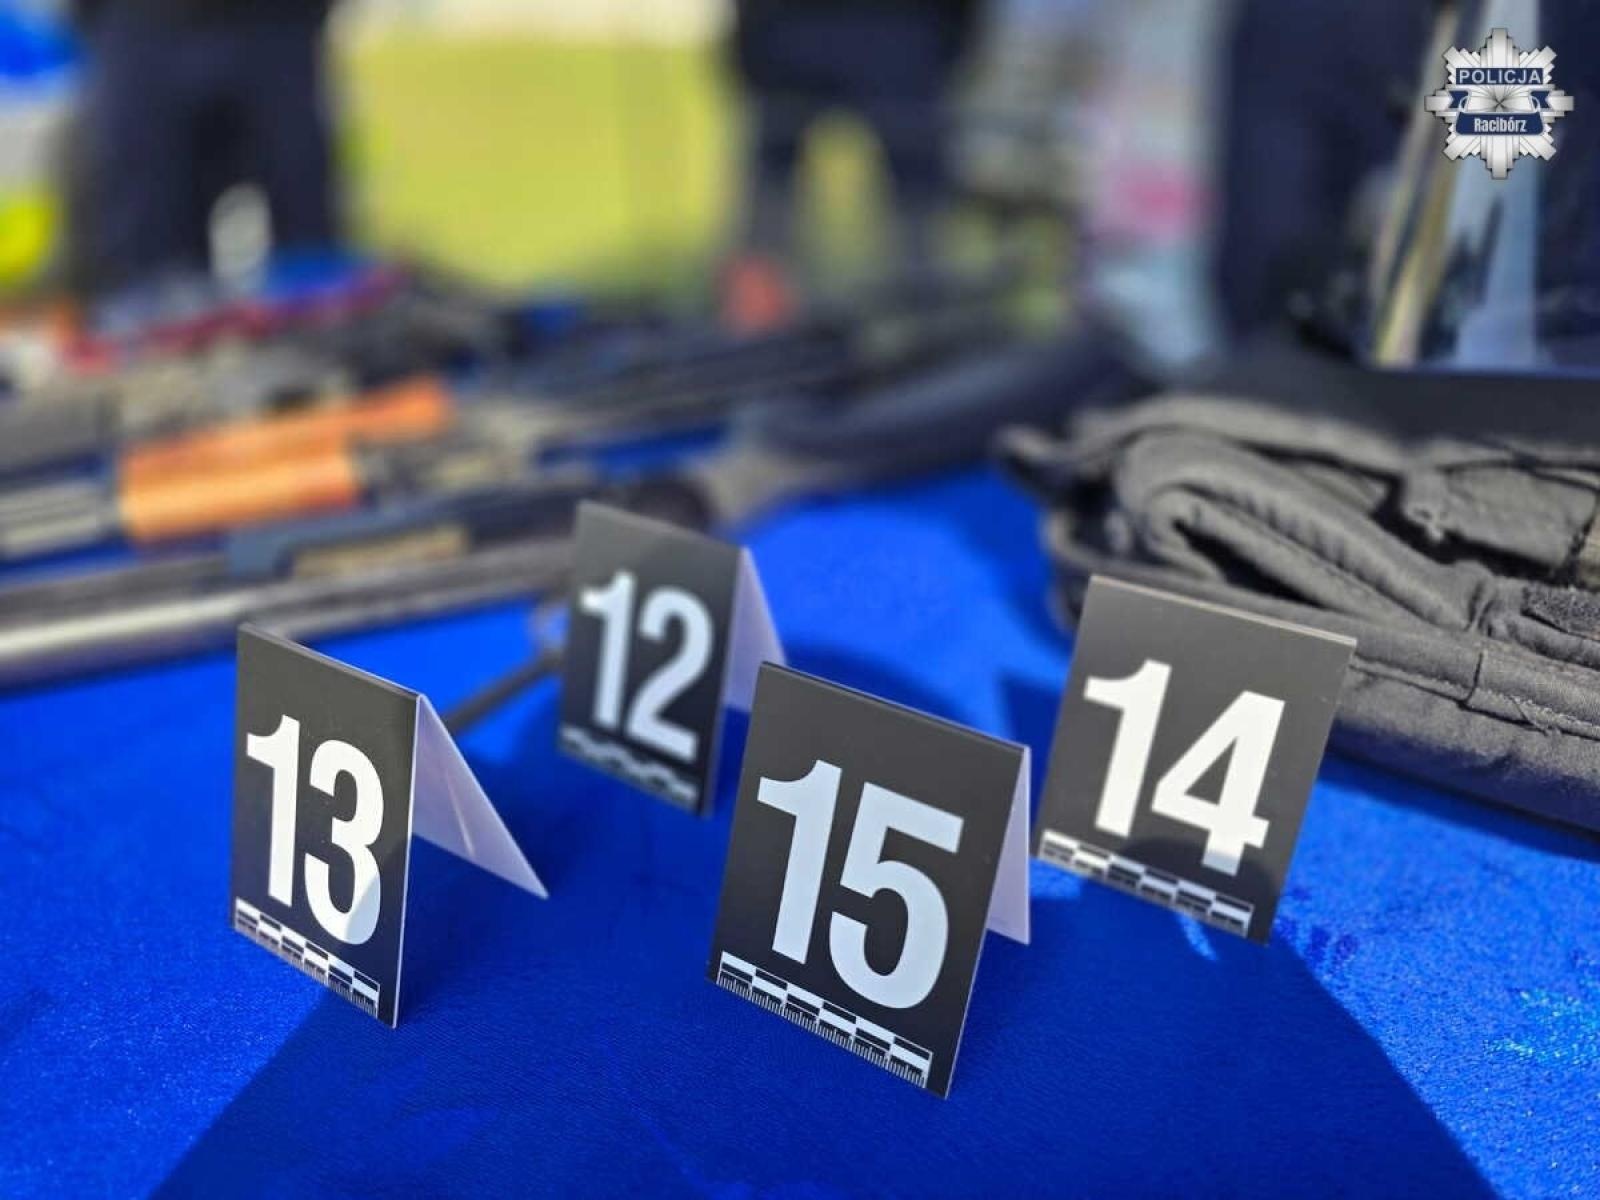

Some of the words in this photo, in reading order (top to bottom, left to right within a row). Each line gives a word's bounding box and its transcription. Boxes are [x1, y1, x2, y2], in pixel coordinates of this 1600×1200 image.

[579, 569, 712, 762] 12
[1084, 658, 1285, 876] 14
[246, 714, 384, 945] 13
[757, 759, 964, 1009] 15
